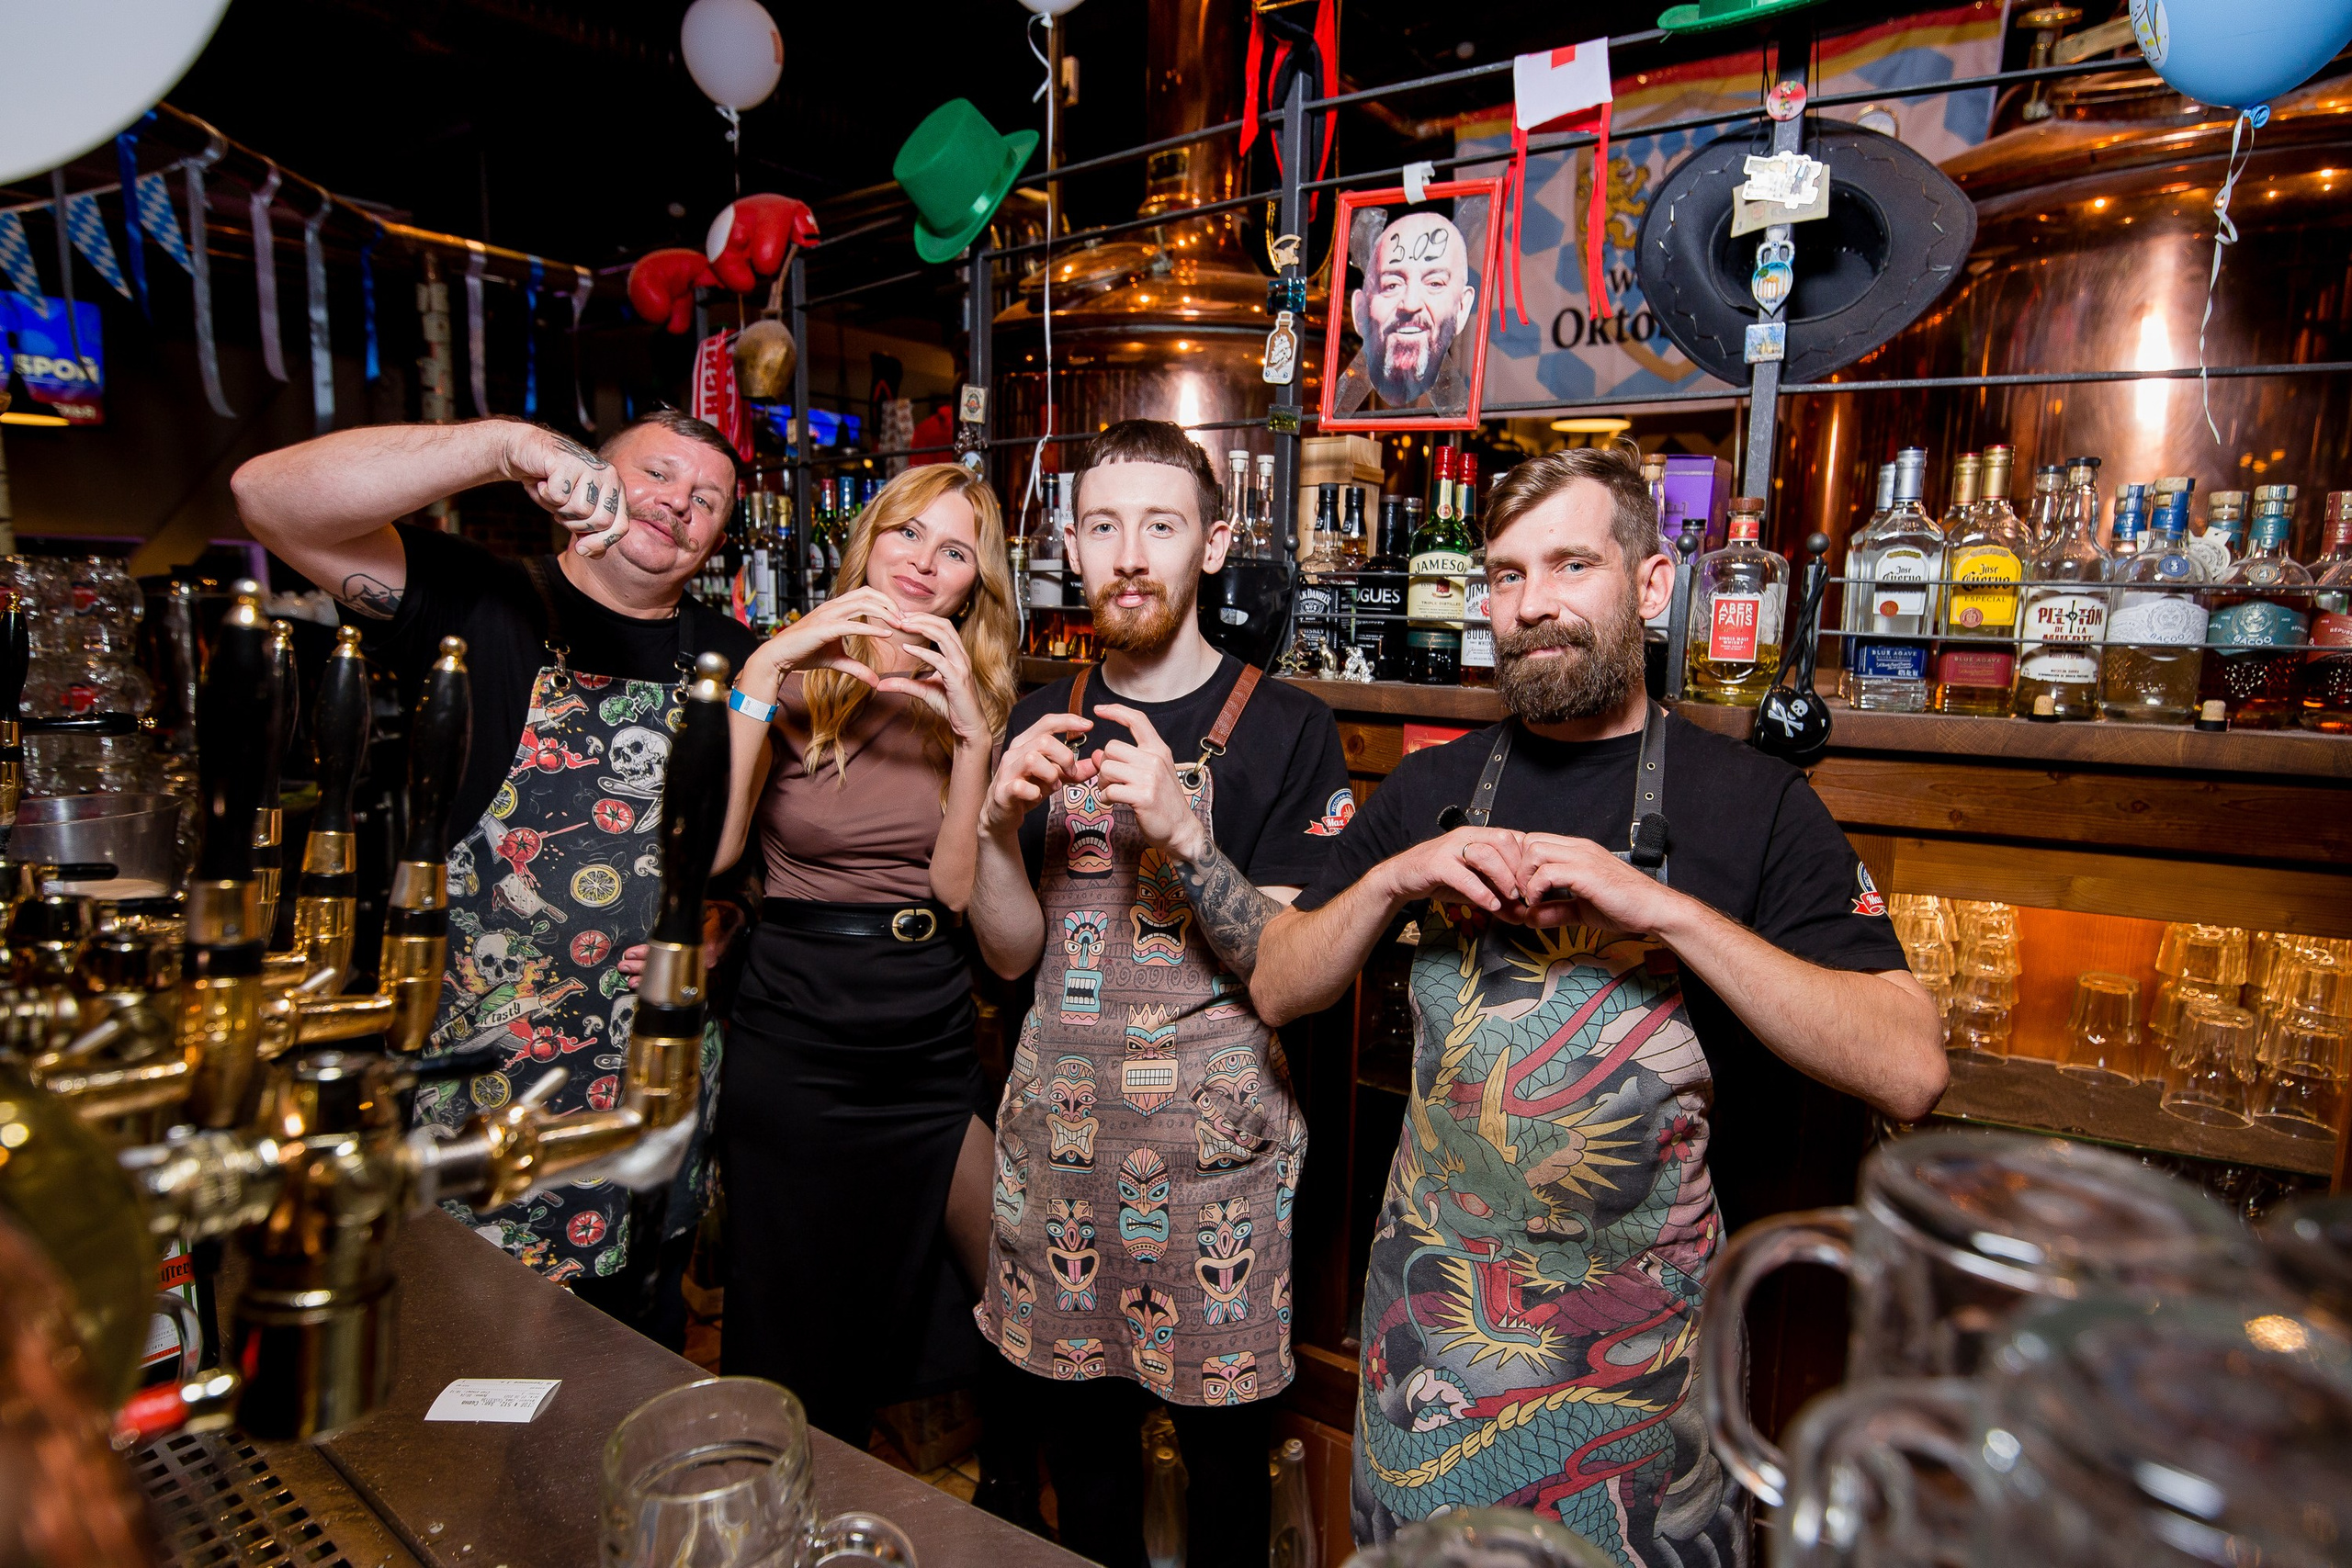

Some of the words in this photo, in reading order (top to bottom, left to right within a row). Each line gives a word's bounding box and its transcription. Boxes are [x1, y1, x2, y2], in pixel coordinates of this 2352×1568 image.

[1388, 228, 1449, 265] 3.09
[1415, 558, 1467, 574] JAMESO
[1895, 565, 1912, 575] Jose
[1979, 563, 1999, 576] Jose
[1306, 588, 1332, 605] DANIEL'S
[1465, 583, 1486, 604] JIM
[1963, 594, 2007, 604] ESPECIAL
[1718, 602, 1753, 615] ABER
[1466, 627, 1490, 640] BOUR
[2149, 631, 2186, 643] BACOO
[492, 1001, 521, 1023] tasty
